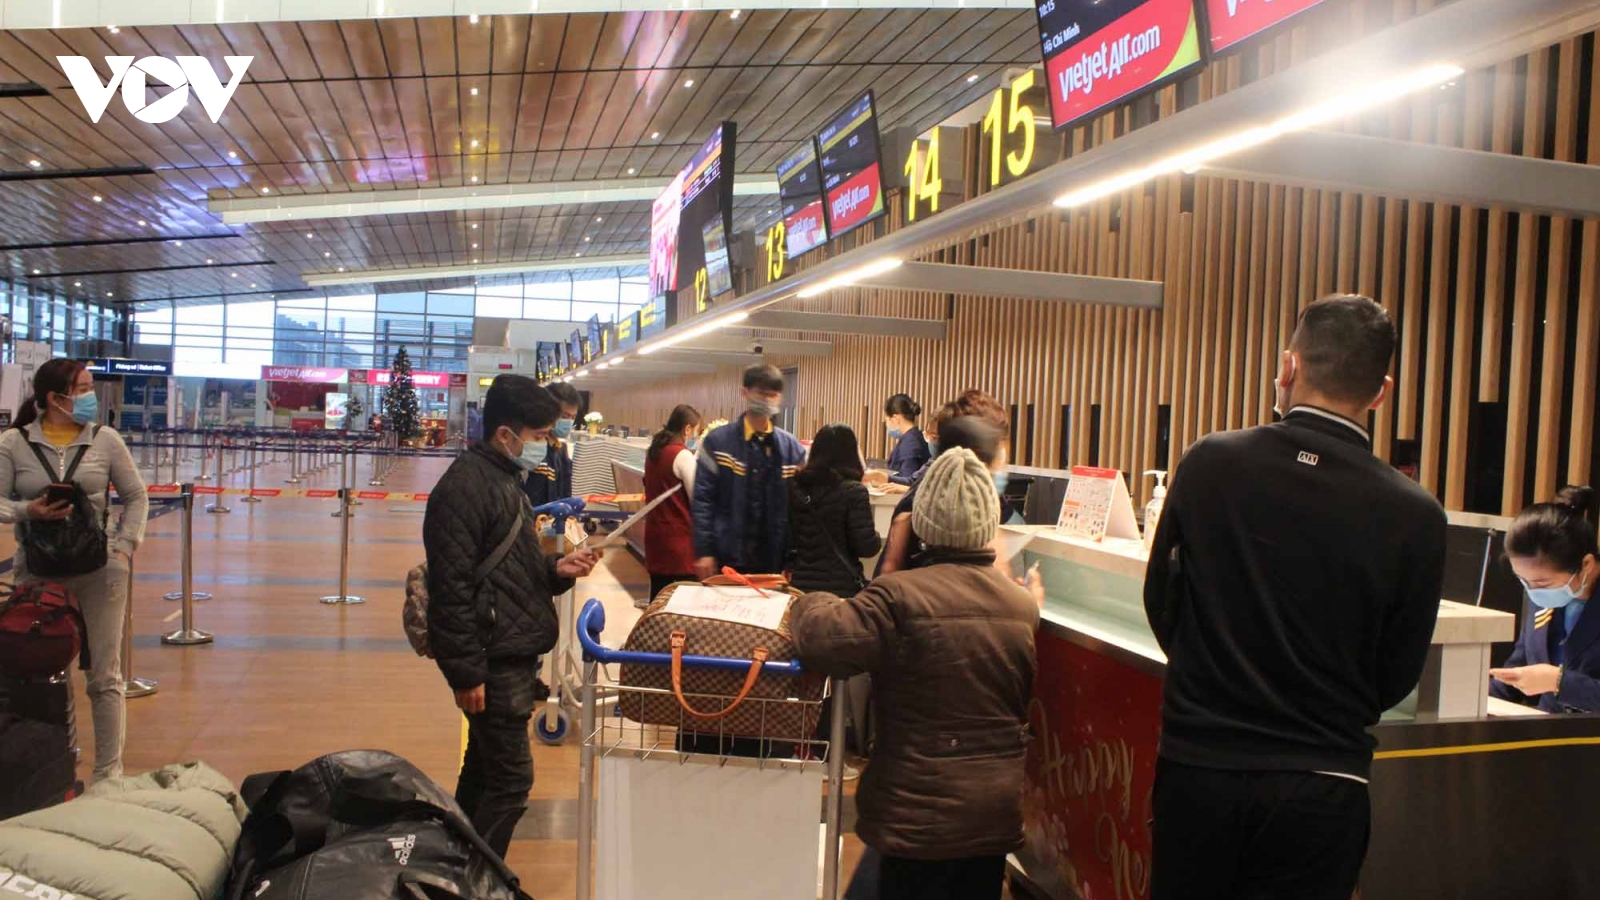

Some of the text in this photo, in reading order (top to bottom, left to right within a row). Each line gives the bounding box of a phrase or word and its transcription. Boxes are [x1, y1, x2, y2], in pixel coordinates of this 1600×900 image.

[984, 69, 1035, 186] 15
[904, 126, 942, 221] 14
[765, 221, 785, 282] 13
[694, 267, 707, 313] 12
[399, 834, 416, 866] adidas
